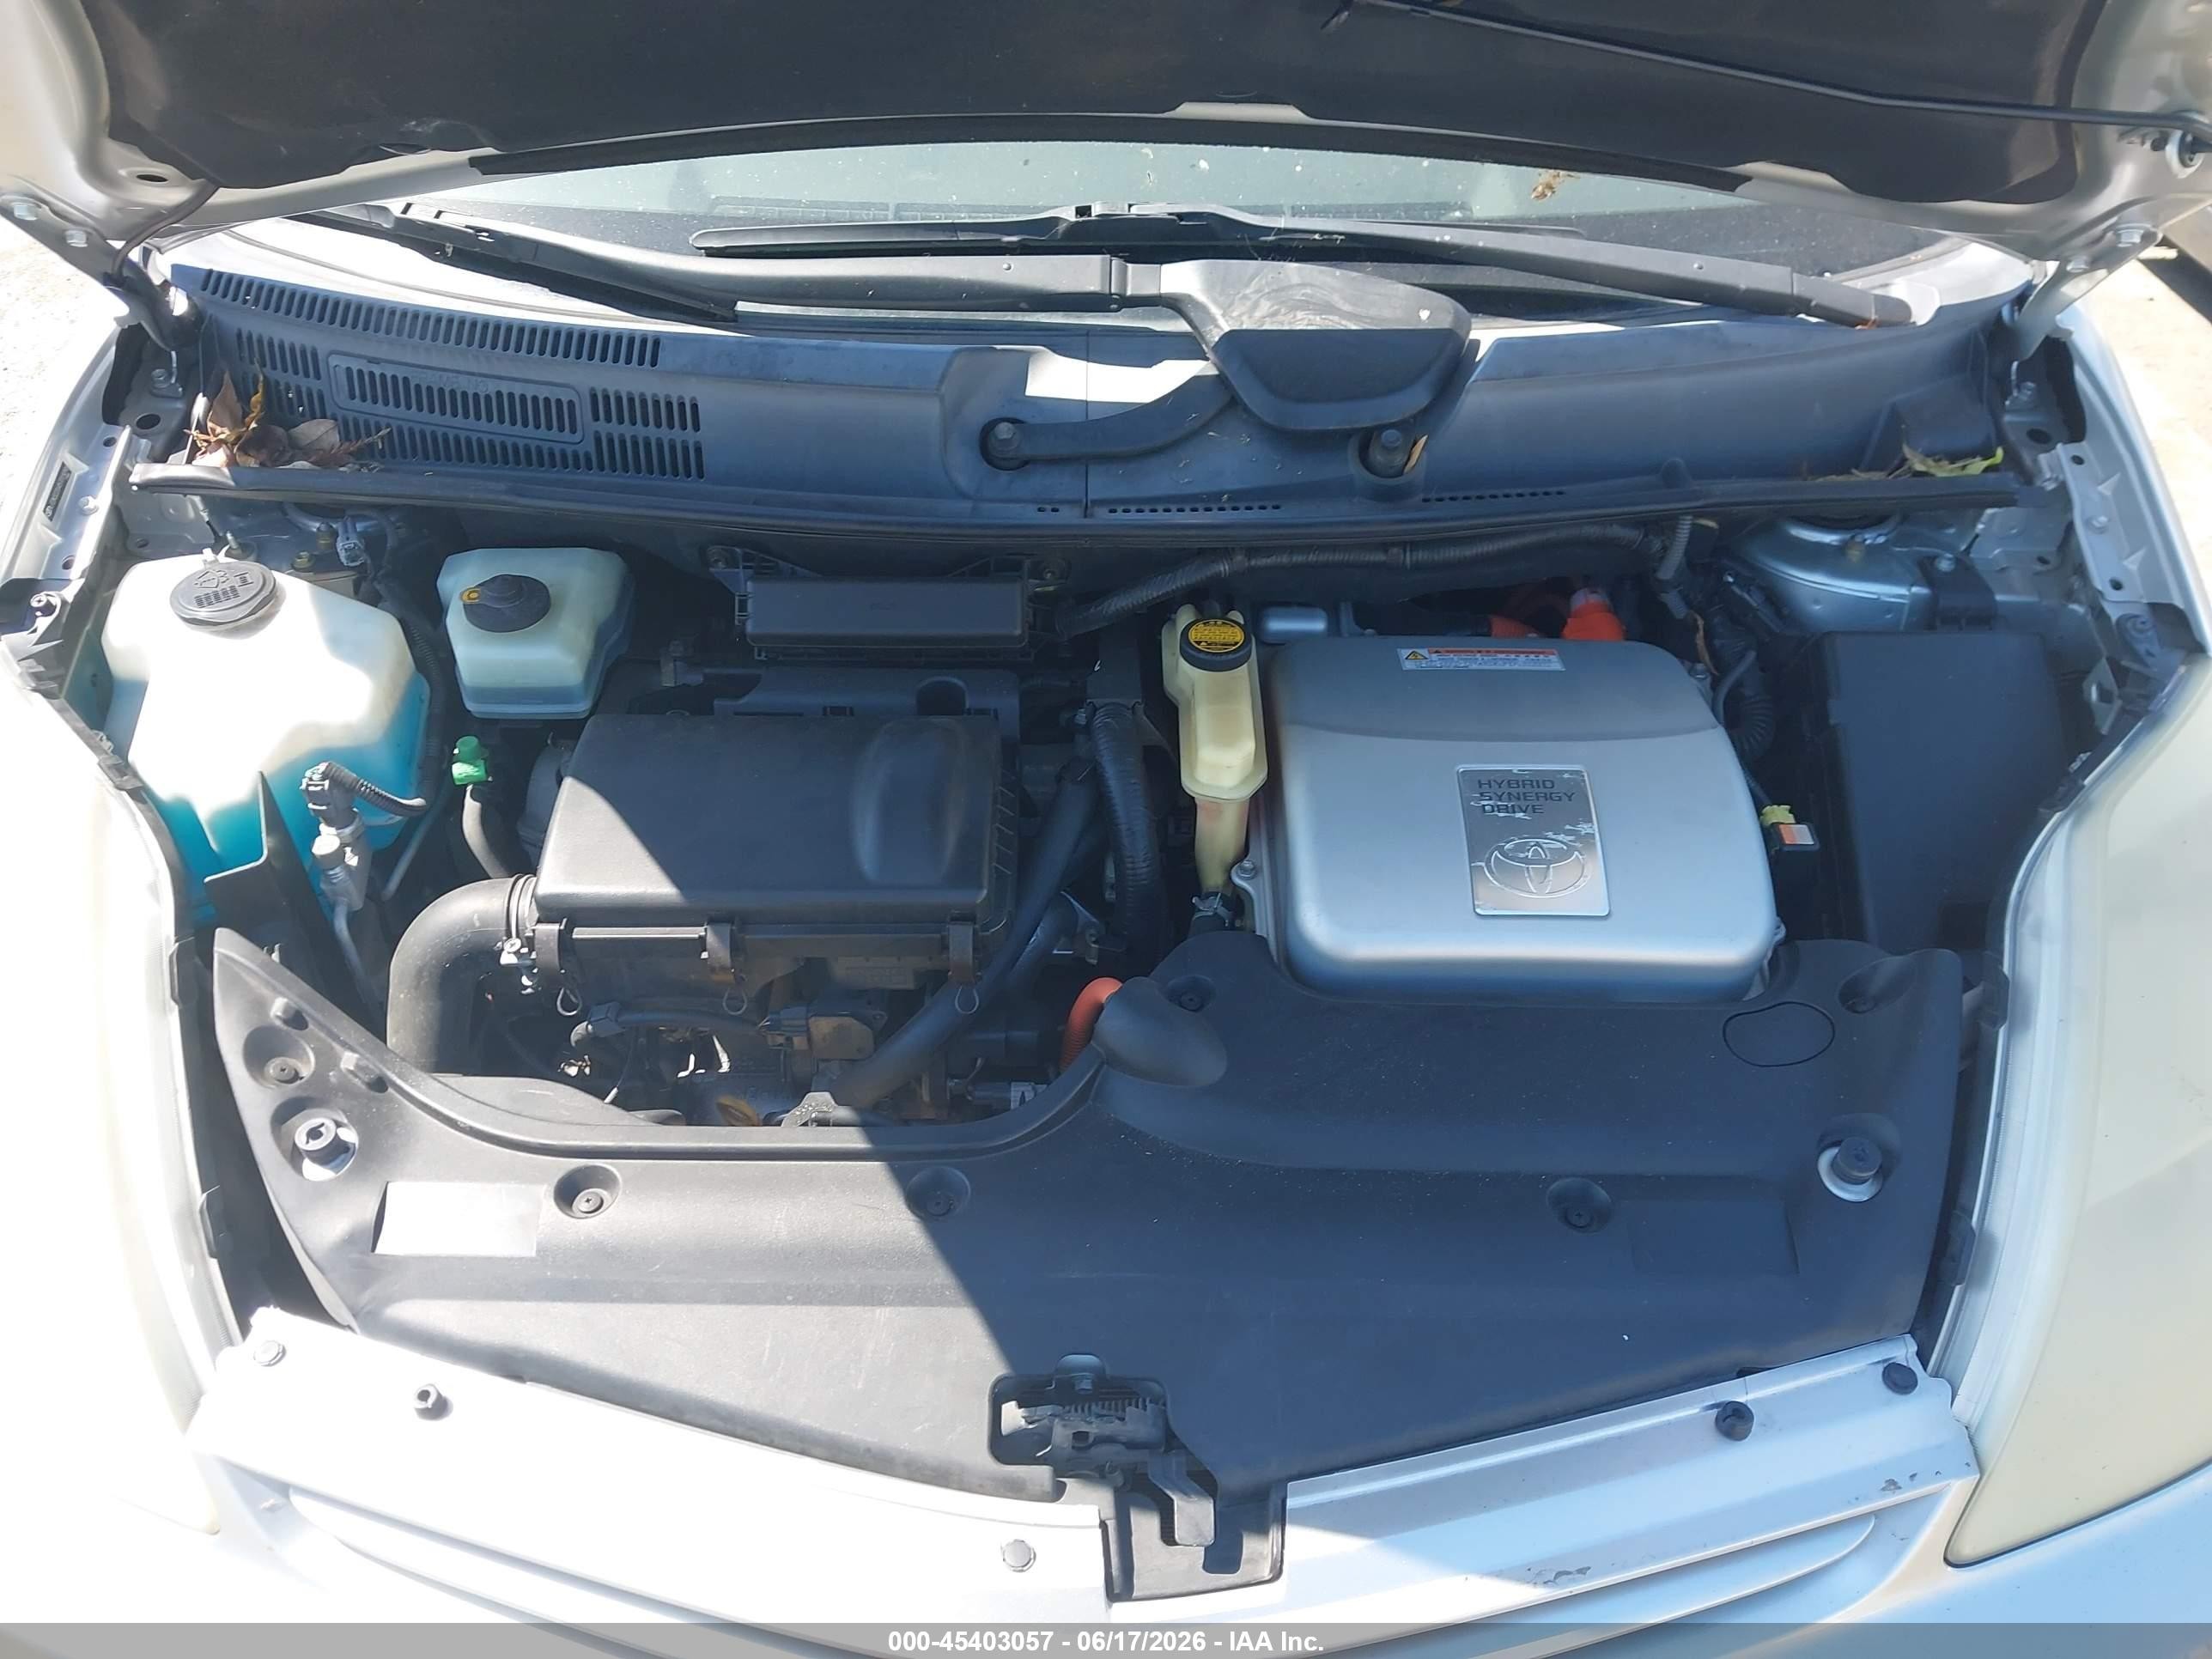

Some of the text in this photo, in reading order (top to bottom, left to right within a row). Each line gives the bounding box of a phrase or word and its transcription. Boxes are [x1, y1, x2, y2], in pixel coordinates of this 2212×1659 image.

[1477, 779, 1555, 789] HYBRID
[1480, 791, 1576, 802] SYNERGY
[1482, 804, 1544, 814] DRIVE
